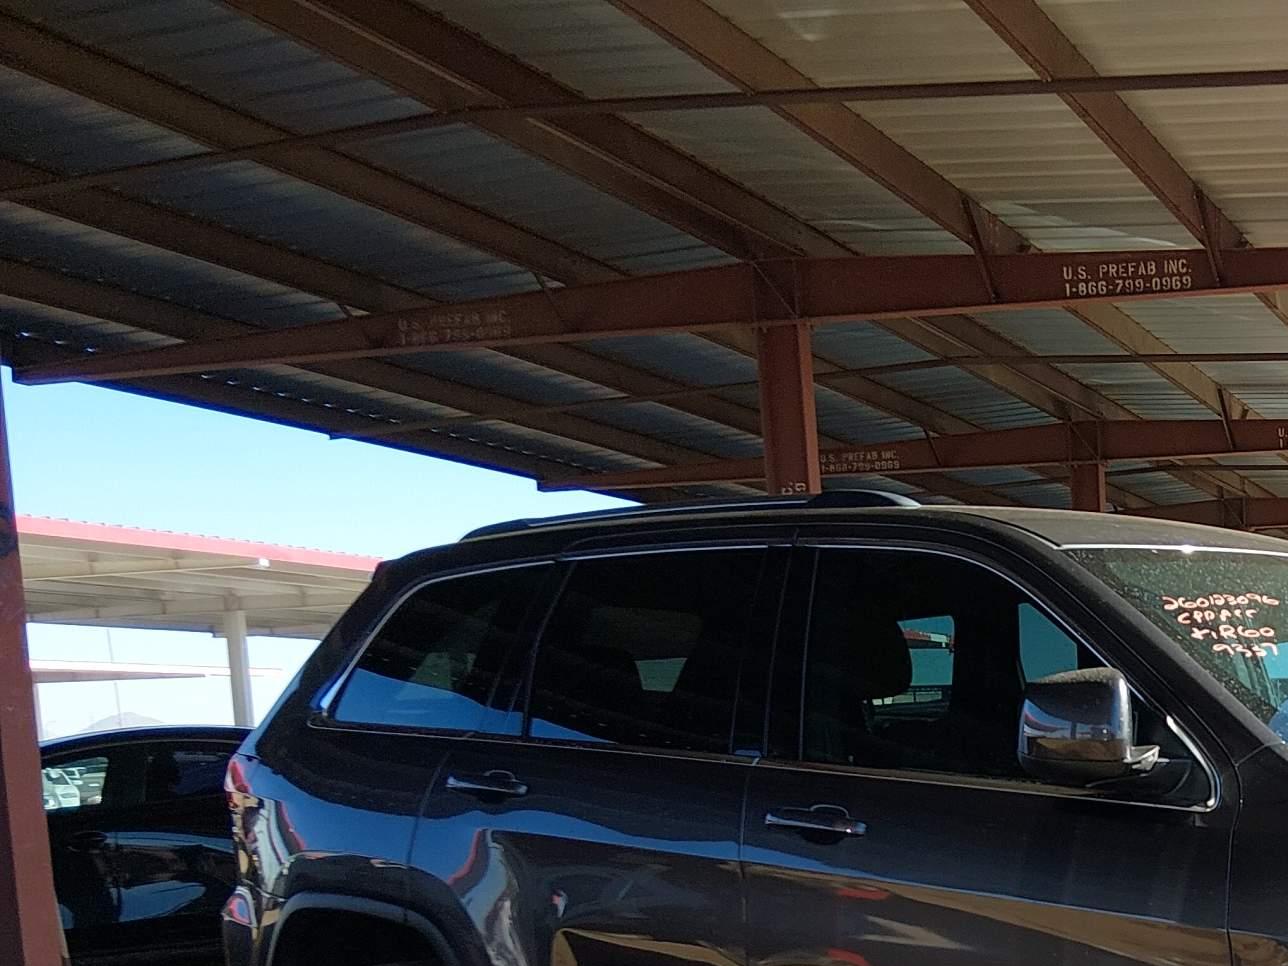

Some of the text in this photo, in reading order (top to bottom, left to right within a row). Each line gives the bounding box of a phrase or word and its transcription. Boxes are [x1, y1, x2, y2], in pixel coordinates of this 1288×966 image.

[1062, 258, 1193, 280] U.S. PREFAB INC.
[1064, 275, 1193, 297] 1-866-799-0969
